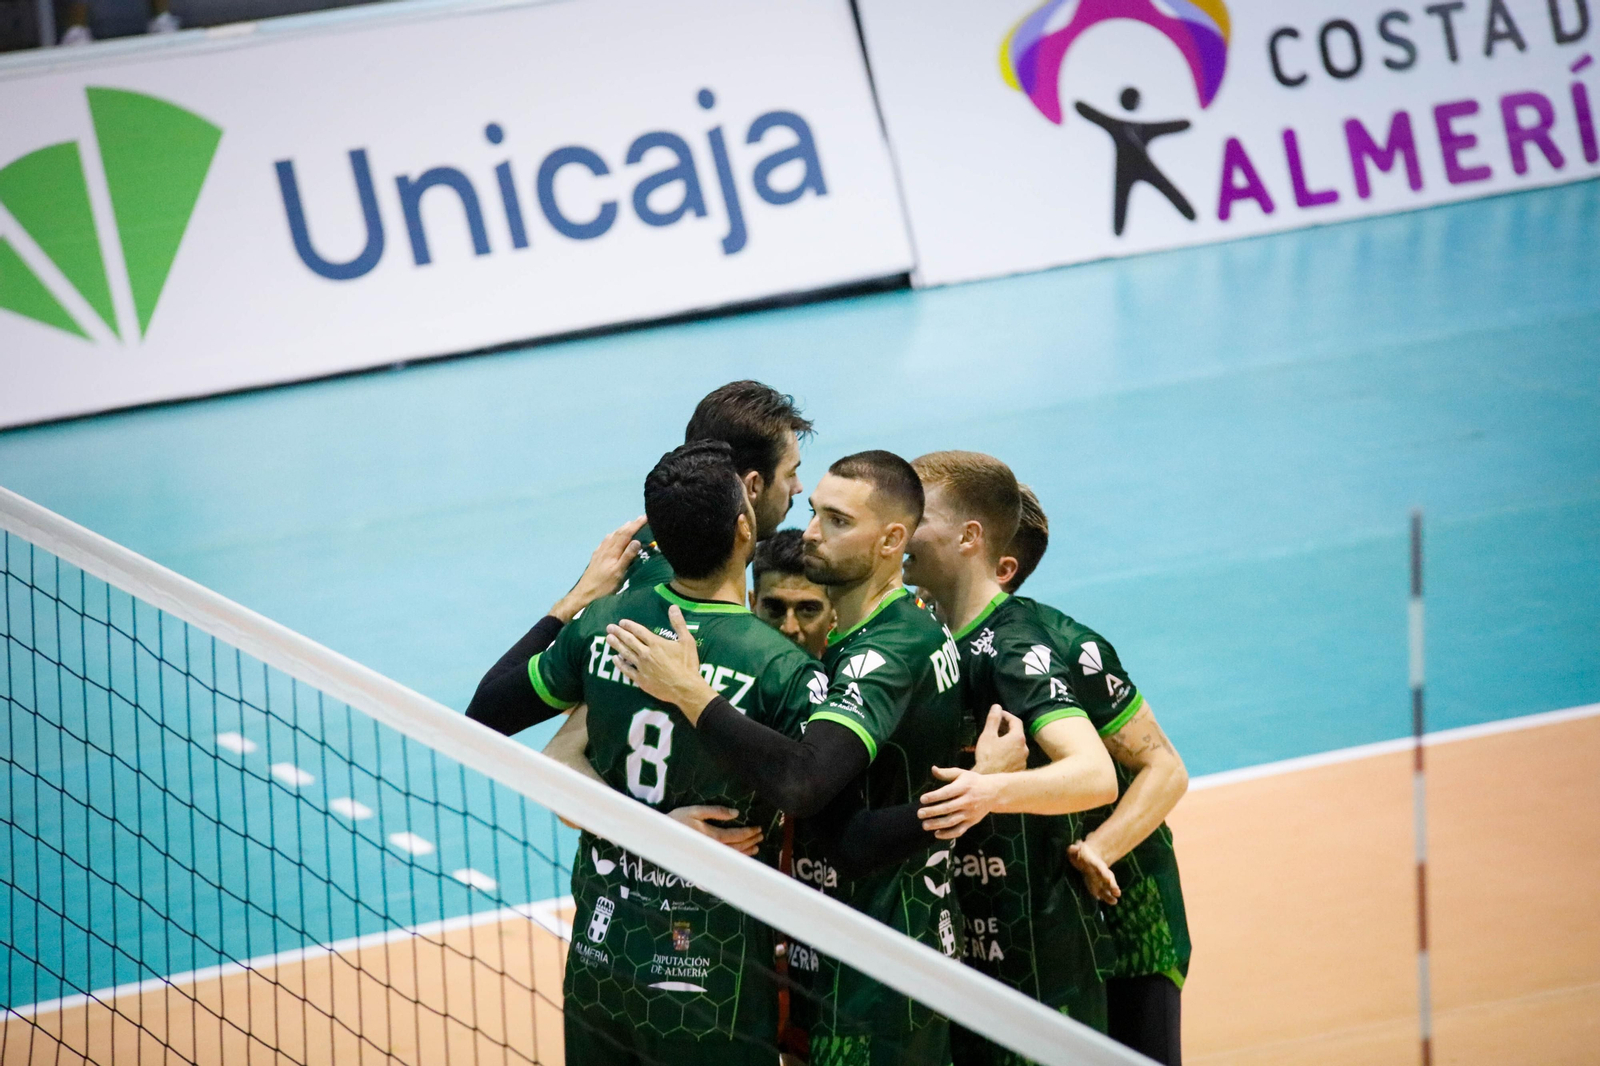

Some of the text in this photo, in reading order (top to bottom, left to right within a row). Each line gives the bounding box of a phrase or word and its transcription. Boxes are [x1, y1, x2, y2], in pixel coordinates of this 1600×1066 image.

[1267, 0, 1527, 87] COSTA
[274, 87, 830, 281] Unicaja
[627, 708, 675, 804] 8
[650, 964, 709, 978] DE ALMERÍA
[653, 953, 711, 967] DIPUTACIÓN
